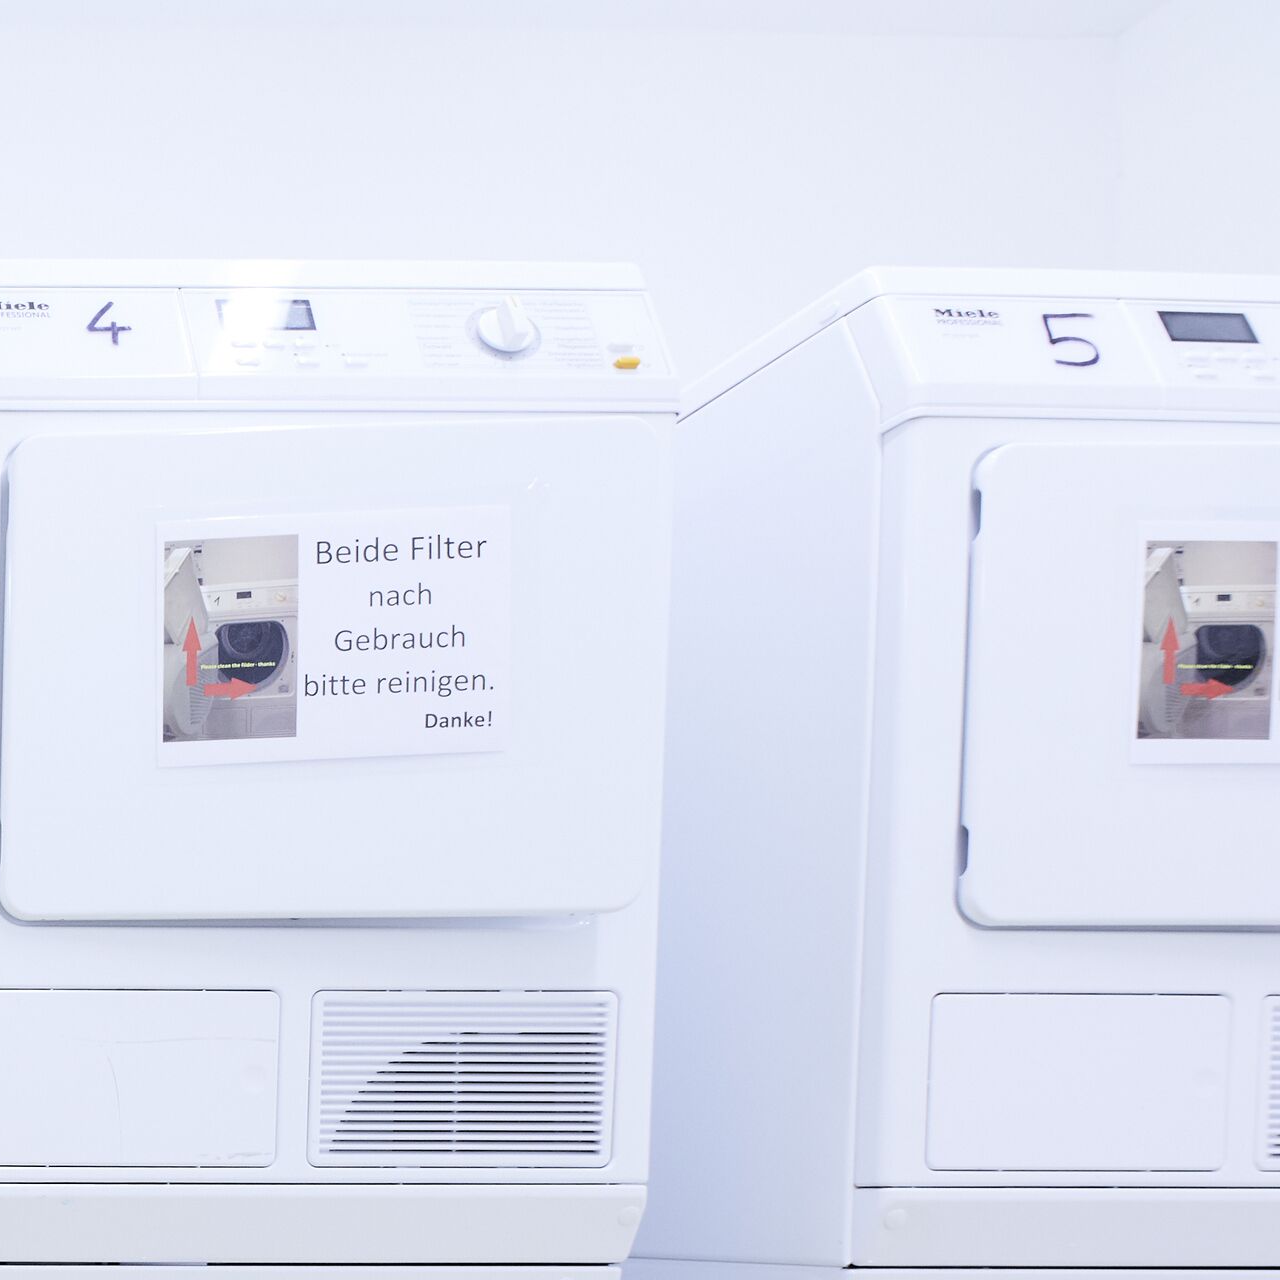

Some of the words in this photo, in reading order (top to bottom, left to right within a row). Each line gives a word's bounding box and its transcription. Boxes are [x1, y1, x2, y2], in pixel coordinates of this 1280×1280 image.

[86, 301, 132, 346] 4
[935, 309, 997, 317] Miele
[1041, 312, 1100, 368] 5
[316, 536, 399, 565] Beide
[411, 534, 487, 561] Filter
[369, 582, 432, 607] nach
[334, 624, 465, 652] Gebrauch
[304, 673, 366, 697] bitte
[377, 669, 494, 698] reinigen.
[425, 710, 492, 729] Danke!
